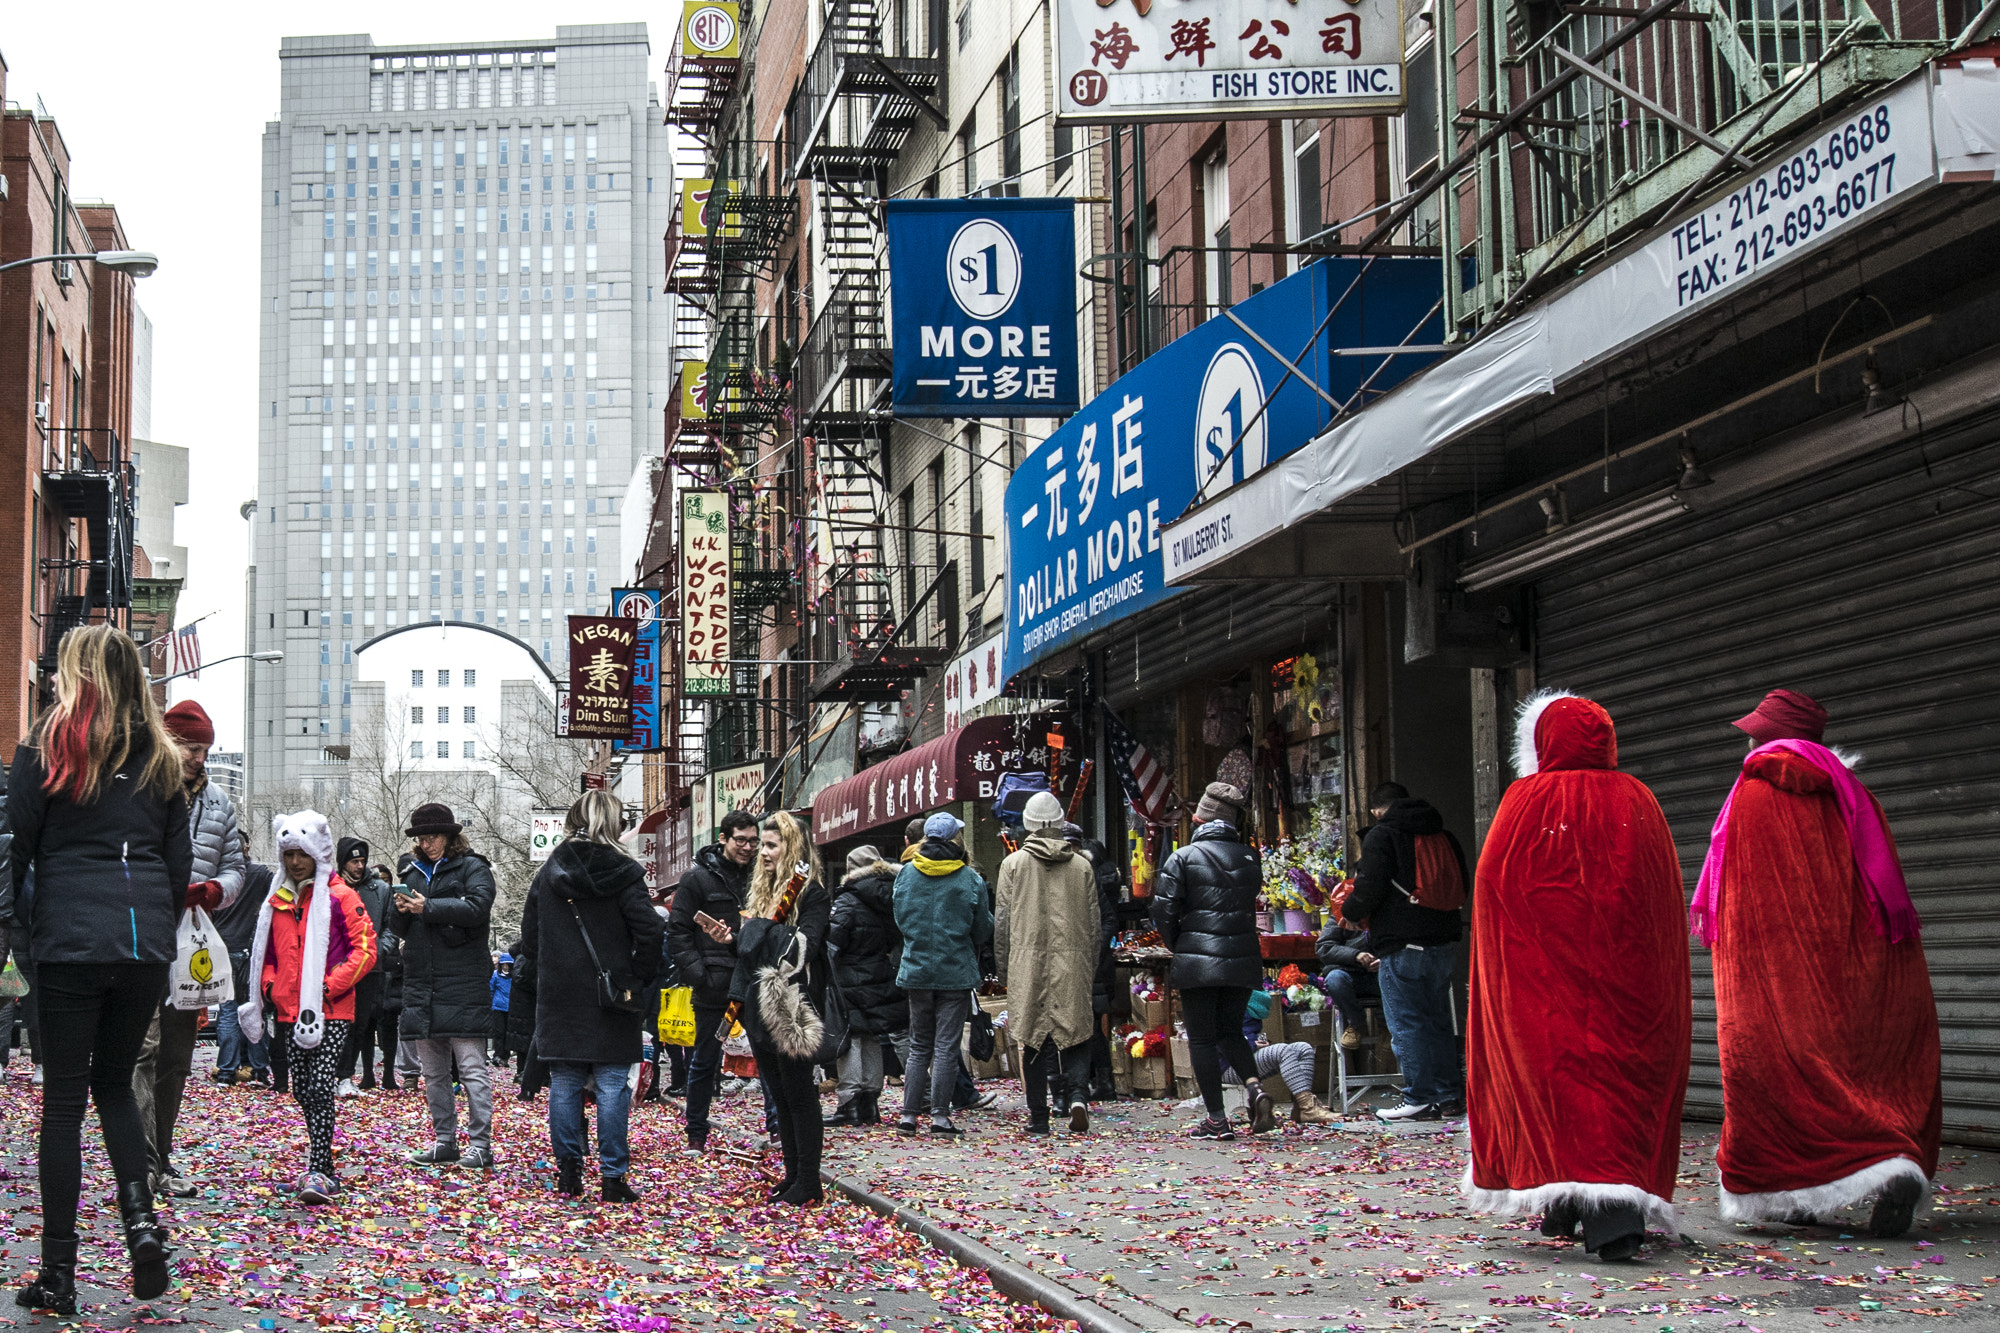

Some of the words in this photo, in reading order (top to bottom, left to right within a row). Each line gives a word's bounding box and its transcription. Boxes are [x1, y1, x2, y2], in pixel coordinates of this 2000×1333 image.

[1089, 12, 1361, 70] 海鮮公司
[1074, 74, 1101, 100] 87
[1212, 72, 1258, 98] FISH
[1267, 70, 1337, 97] STORE
[1347, 67, 1394, 94] INC.
[1672, 213, 1722, 261] TEL:
[1729, 105, 1891, 231] 212-693-6688
[1677, 253, 1727, 307] FAX:
[1735, 153, 1896, 275] 212-693-6677
[959, 243, 1005, 296] $1
[920, 325, 1050, 358] MORE
[916, 365, 1058, 399] 一元多店
[1021, 393, 1144, 541] 一元多店
[692, 536, 722, 551] H.K.
[1018, 548, 1078, 628] DOLLAR
[1087, 498, 1159, 585] MORE
[1172, 541, 1181, 568] 87
[1182, 521, 1219, 563] MULBERRY
[1221, 514, 1234, 543] ST.
[686, 555, 708, 666] WONTON
[707, 561, 728, 676] GARDEN
[1060, 607, 1088, 633] GENERAL
[1088, 570, 1144, 617] MERCHANDISE
[572, 623, 634, 647] VEGAN
[578, 647, 629, 694] 素
[576, 708, 600, 722] Dim
[602, 710, 629, 724] Sum
[533, 819, 549, 832] Pho
